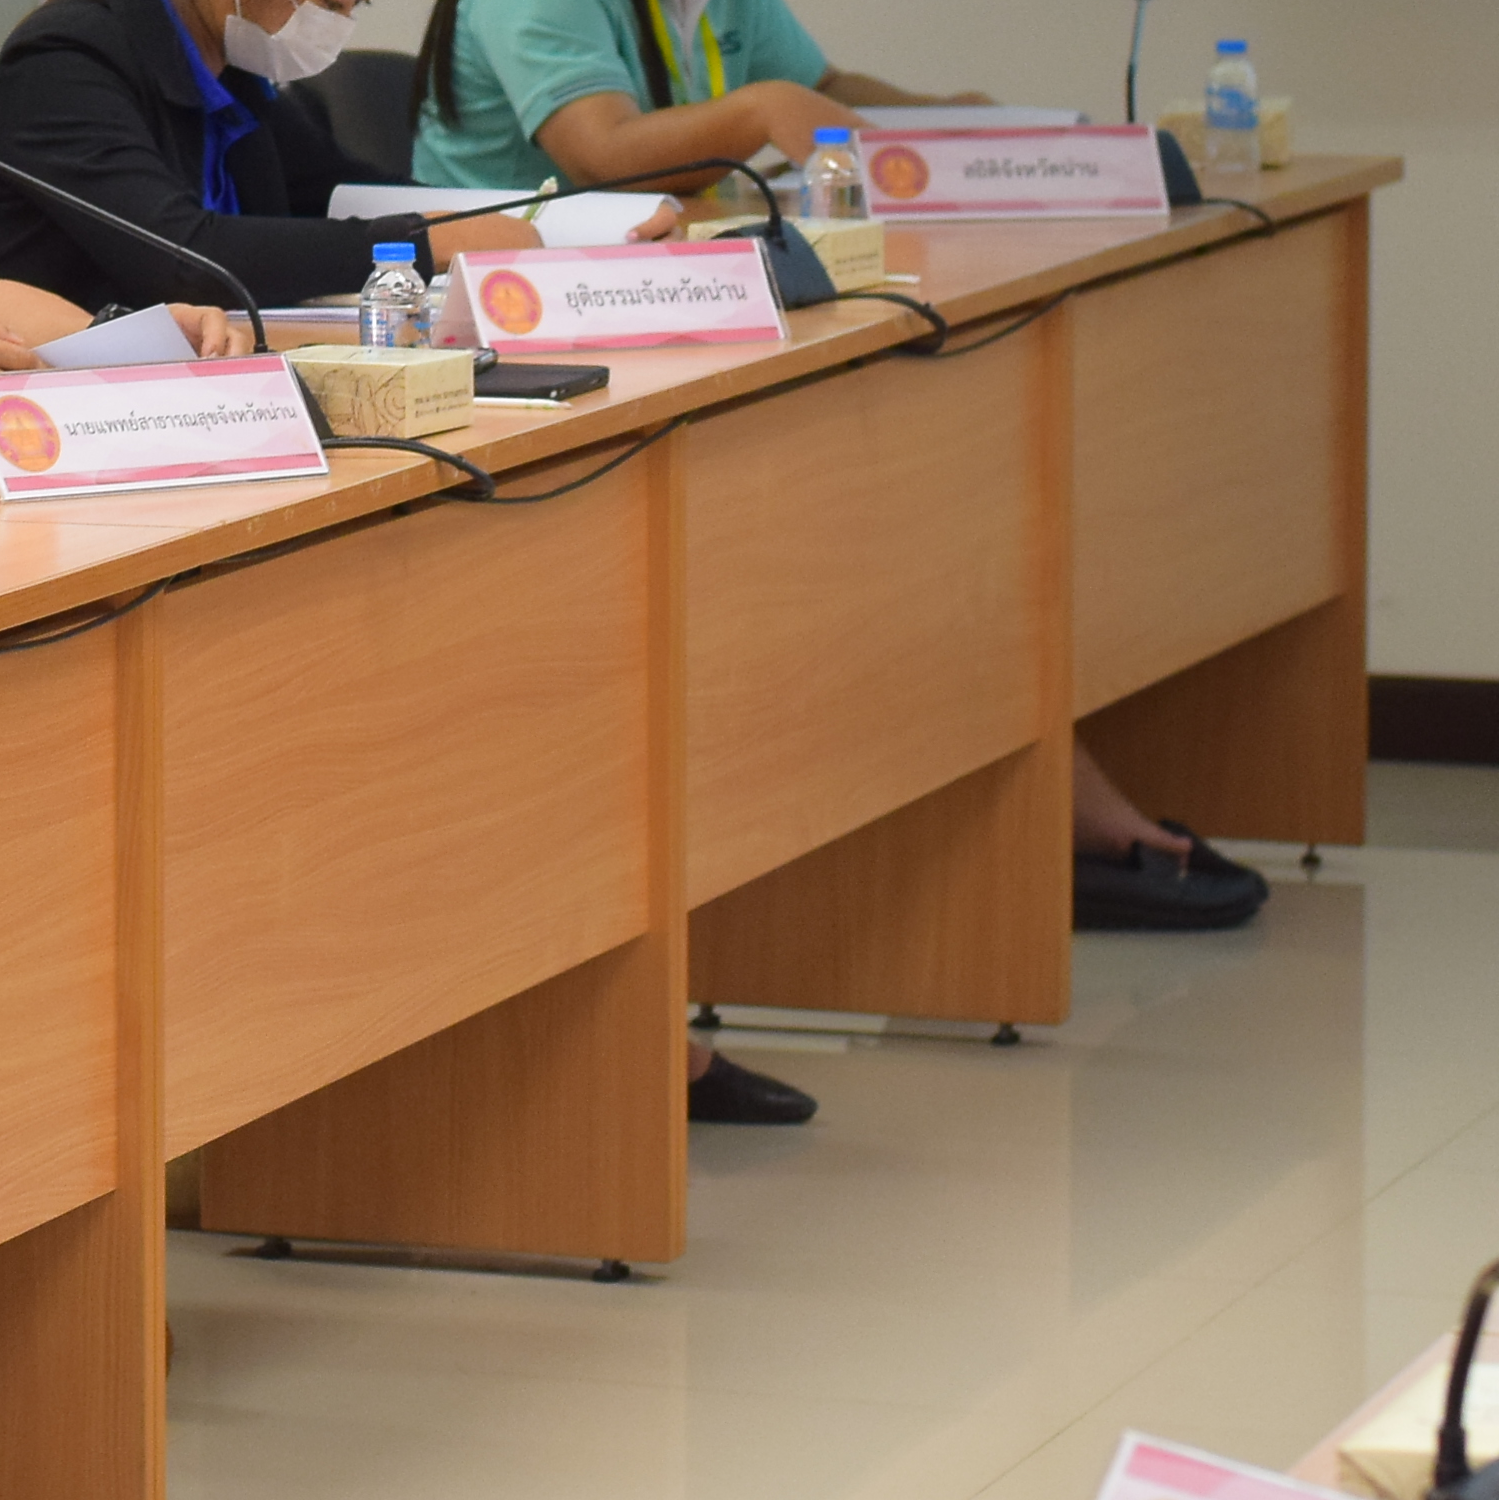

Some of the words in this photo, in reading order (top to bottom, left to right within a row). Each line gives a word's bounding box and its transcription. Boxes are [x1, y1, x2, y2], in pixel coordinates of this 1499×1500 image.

[565, 277, 748, 317] ยุติธรรมจังหวัดน่าน
[64, 401, 298, 436] นายแพทย์สาธารณสุขจังหวัดน่าน
